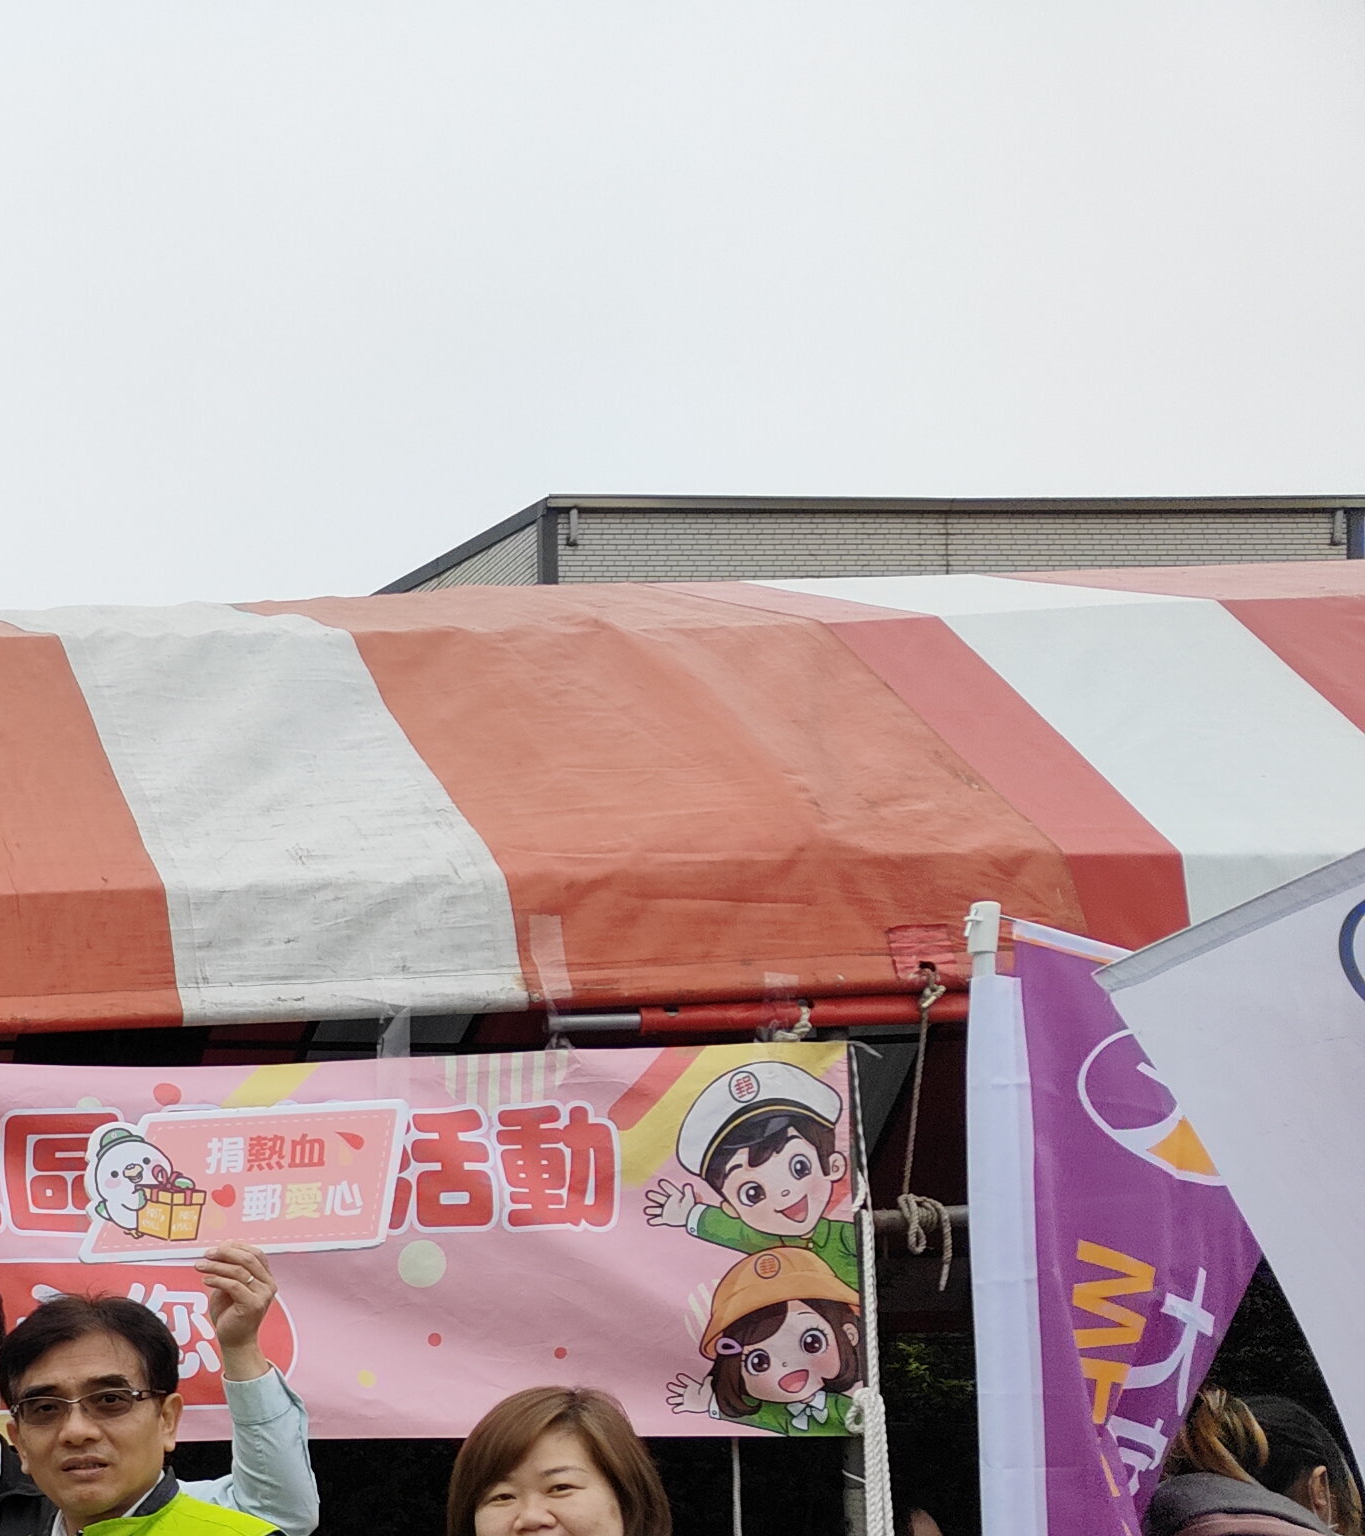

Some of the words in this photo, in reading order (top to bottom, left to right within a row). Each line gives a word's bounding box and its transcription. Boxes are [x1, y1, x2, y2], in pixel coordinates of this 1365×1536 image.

[205, 1133, 326, 1175] 捐熱血
[241, 1179, 364, 1222] 郵愛心
